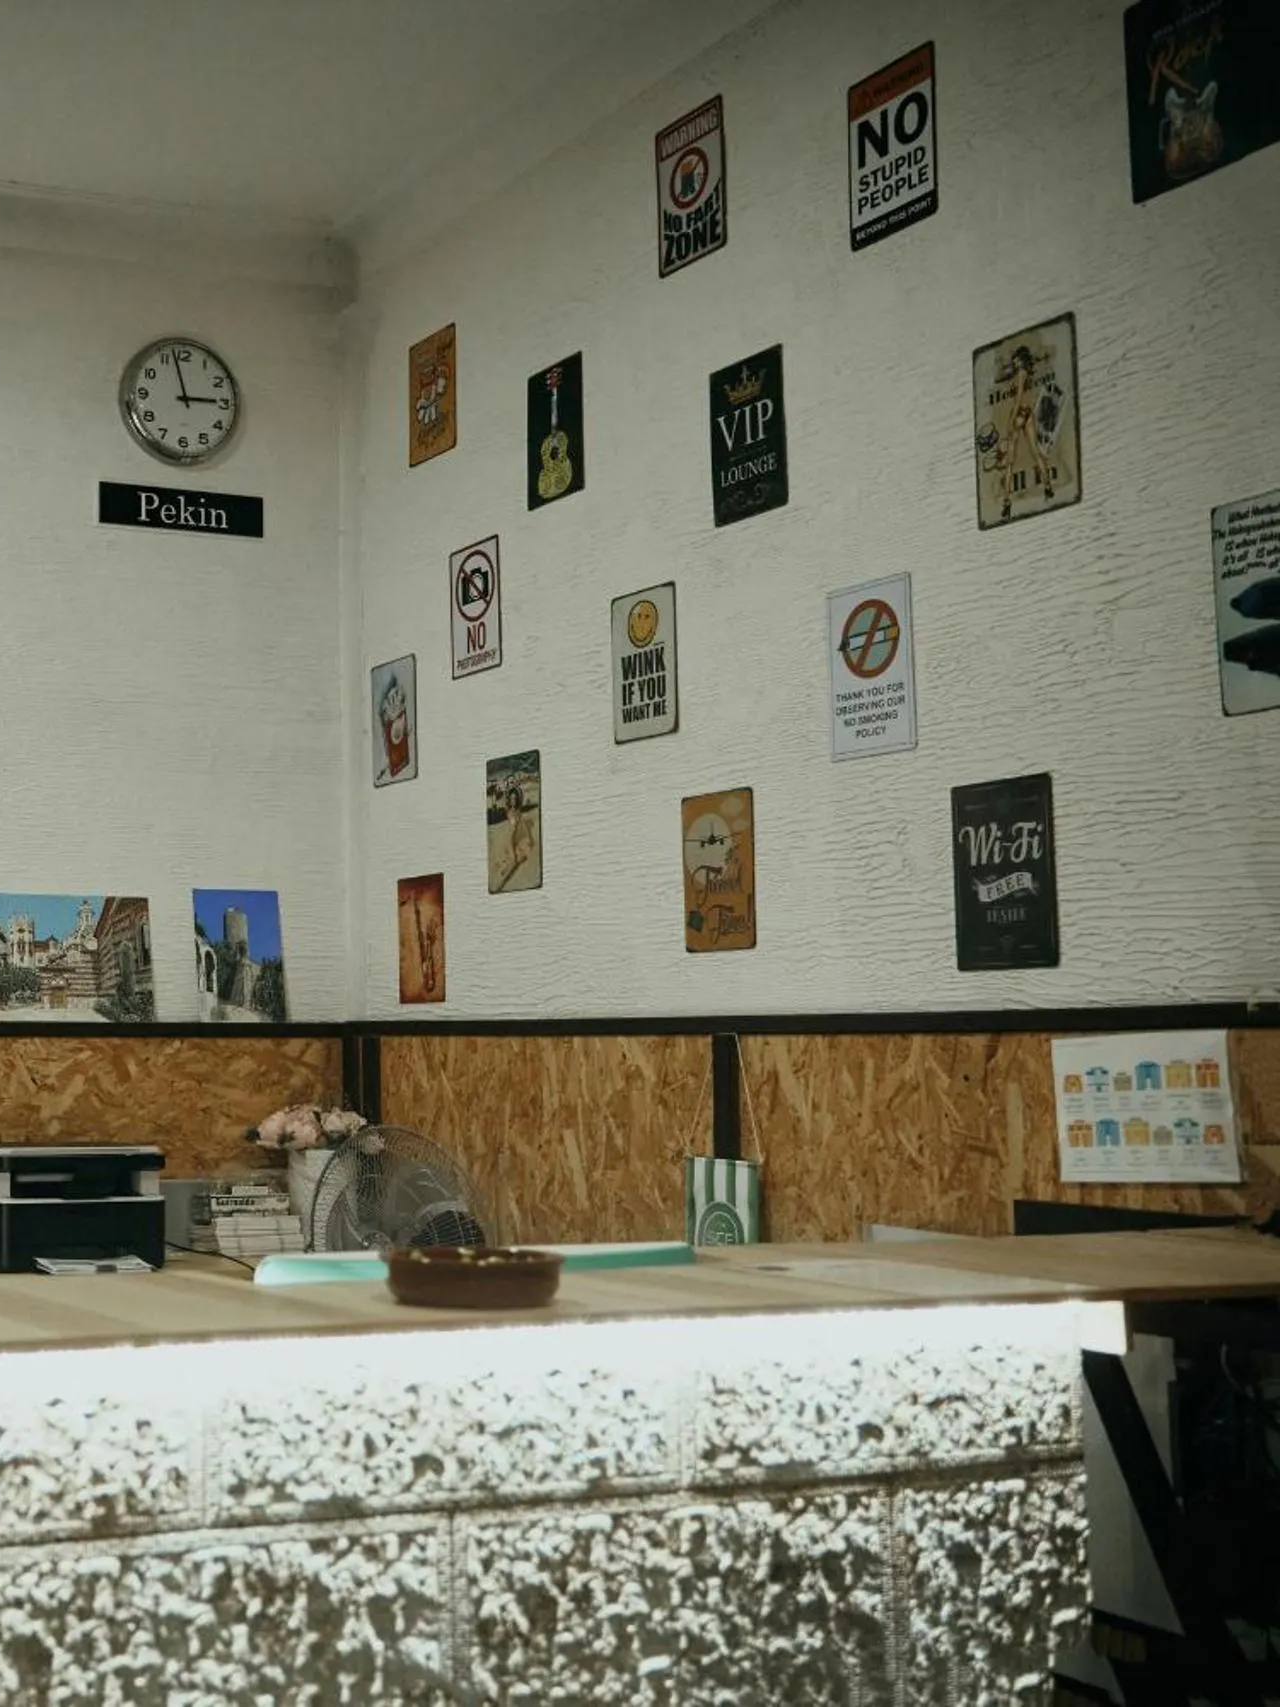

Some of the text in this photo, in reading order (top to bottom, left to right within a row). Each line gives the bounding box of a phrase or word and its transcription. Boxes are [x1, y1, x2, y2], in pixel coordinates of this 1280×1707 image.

[660, 108, 718, 155] WARNING
[857, 91, 929, 169] NO
[859, 145, 926, 193] STUPID
[858, 165, 929, 215] PEOPLE
[663, 179, 721, 233] NO FART
[908, 197, 932, 217] POINT
[663, 205, 721, 269] ZONE
[161, 353, 169, 365] 11
[145, 368, 156, 379] 10
[213, 376, 224, 388] 2
[138, 387, 148, 399] 9
[143, 411, 154, 422] 8
[218, 399, 230, 411] 3
[158, 428, 168, 439] 7
[213, 420, 223, 430] 4
[717, 399, 774, 451] VIP
[178, 436, 188, 448] 6
[198, 433, 209, 444] 5
[721, 452, 777, 488] LOUNGE
[137, 491, 228, 528] Pekin
[467, 622, 487, 654] NO
[621, 646, 666, 681] WINK
[622, 674, 666, 707] IF YOU
[836, 681, 904, 702] THANK YOU FOR
[622, 699, 667, 724] WANT ME
[836, 695, 905, 717] OBSERVING OUR
[844, 710, 898, 727] NO SMOKING
[855, 726, 886, 739] POLICY
[959, 821, 1043, 866] Wi-Fi
[986, 874, 1025, 900] FREE
